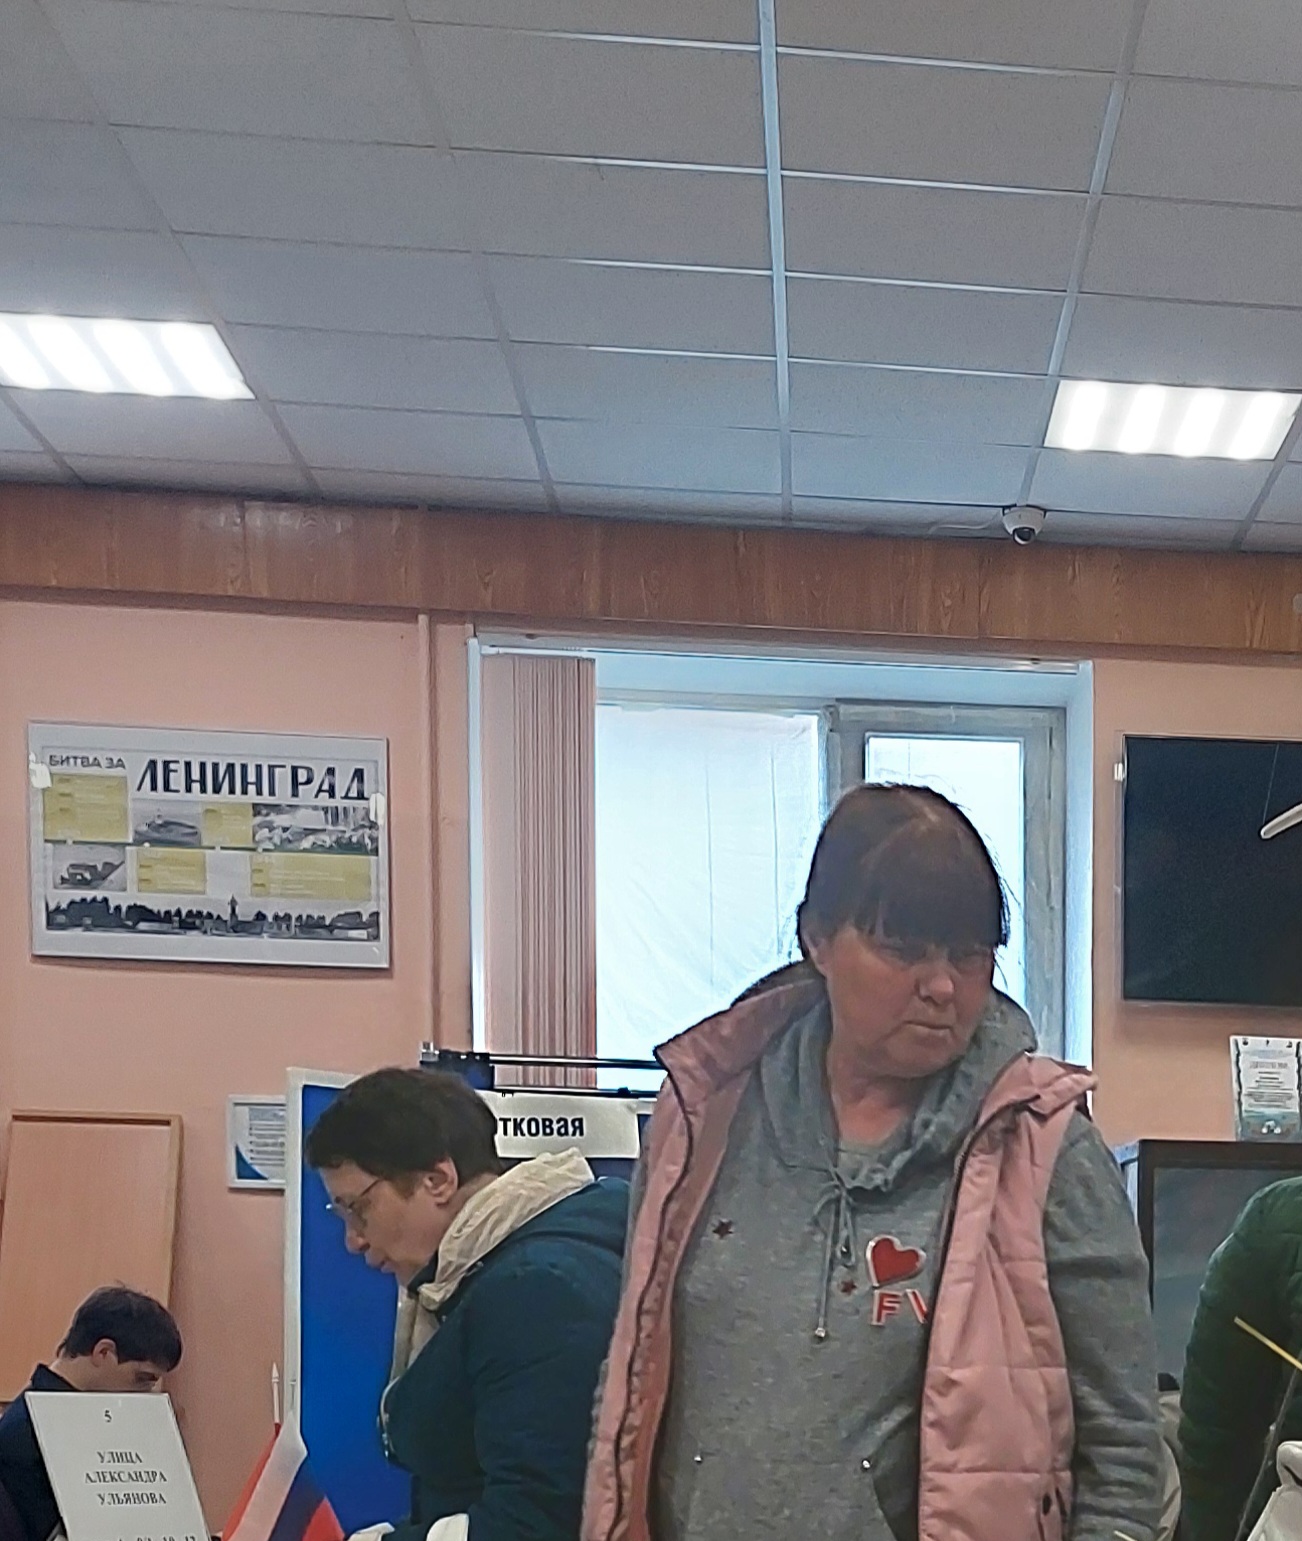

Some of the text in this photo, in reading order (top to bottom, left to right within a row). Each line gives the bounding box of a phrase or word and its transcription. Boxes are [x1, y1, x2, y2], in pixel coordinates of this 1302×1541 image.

[49, 754, 126, 770] БИТВА ЗА
[136, 758, 371, 801] ЛЕНИНГРАД
[494, 1117, 585, 1137] тковая
[104, 1409, 112, 1423] 5
[97, 1450, 143, 1464] УЛИЦА
[84, 1470, 167, 1485] АЛЕКСАНДРА
[97, 1492, 167, 1506] УЛЬЯНОВА
